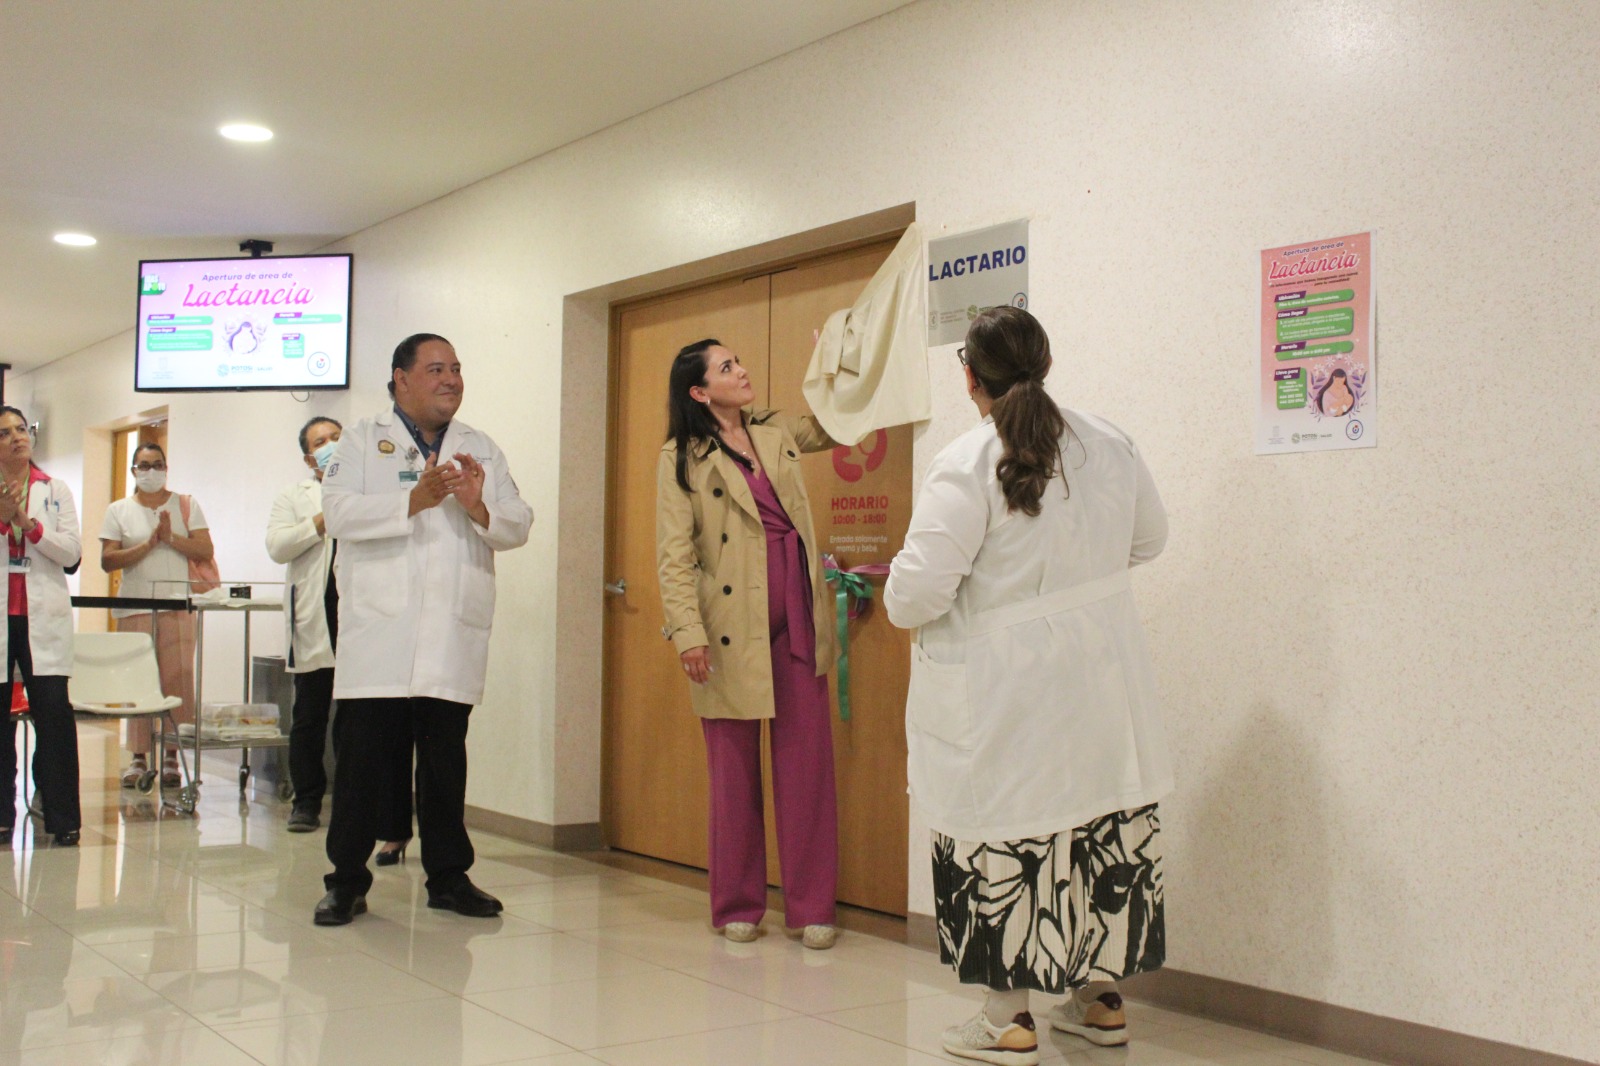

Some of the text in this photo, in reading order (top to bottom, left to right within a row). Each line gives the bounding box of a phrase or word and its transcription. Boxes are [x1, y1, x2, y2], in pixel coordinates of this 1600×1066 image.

[1283, 248, 1310, 257] Apertura
[929, 245, 1026, 282] LACTARIO
[1268, 249, 1359, 280] Lactancia
[202, 273, 243, 283] Apertura
[244, 272, 257, 281] de
[281, 271, 293, 279] de
[182, 281, 315, 308] Lactancia
[831, 495, 889, 511] HORARIO
[832, 514, 856, 525] 10:00
[863, 513, 887, 524] 18:00
[829, 535, 888, 544] Entrada solamente
